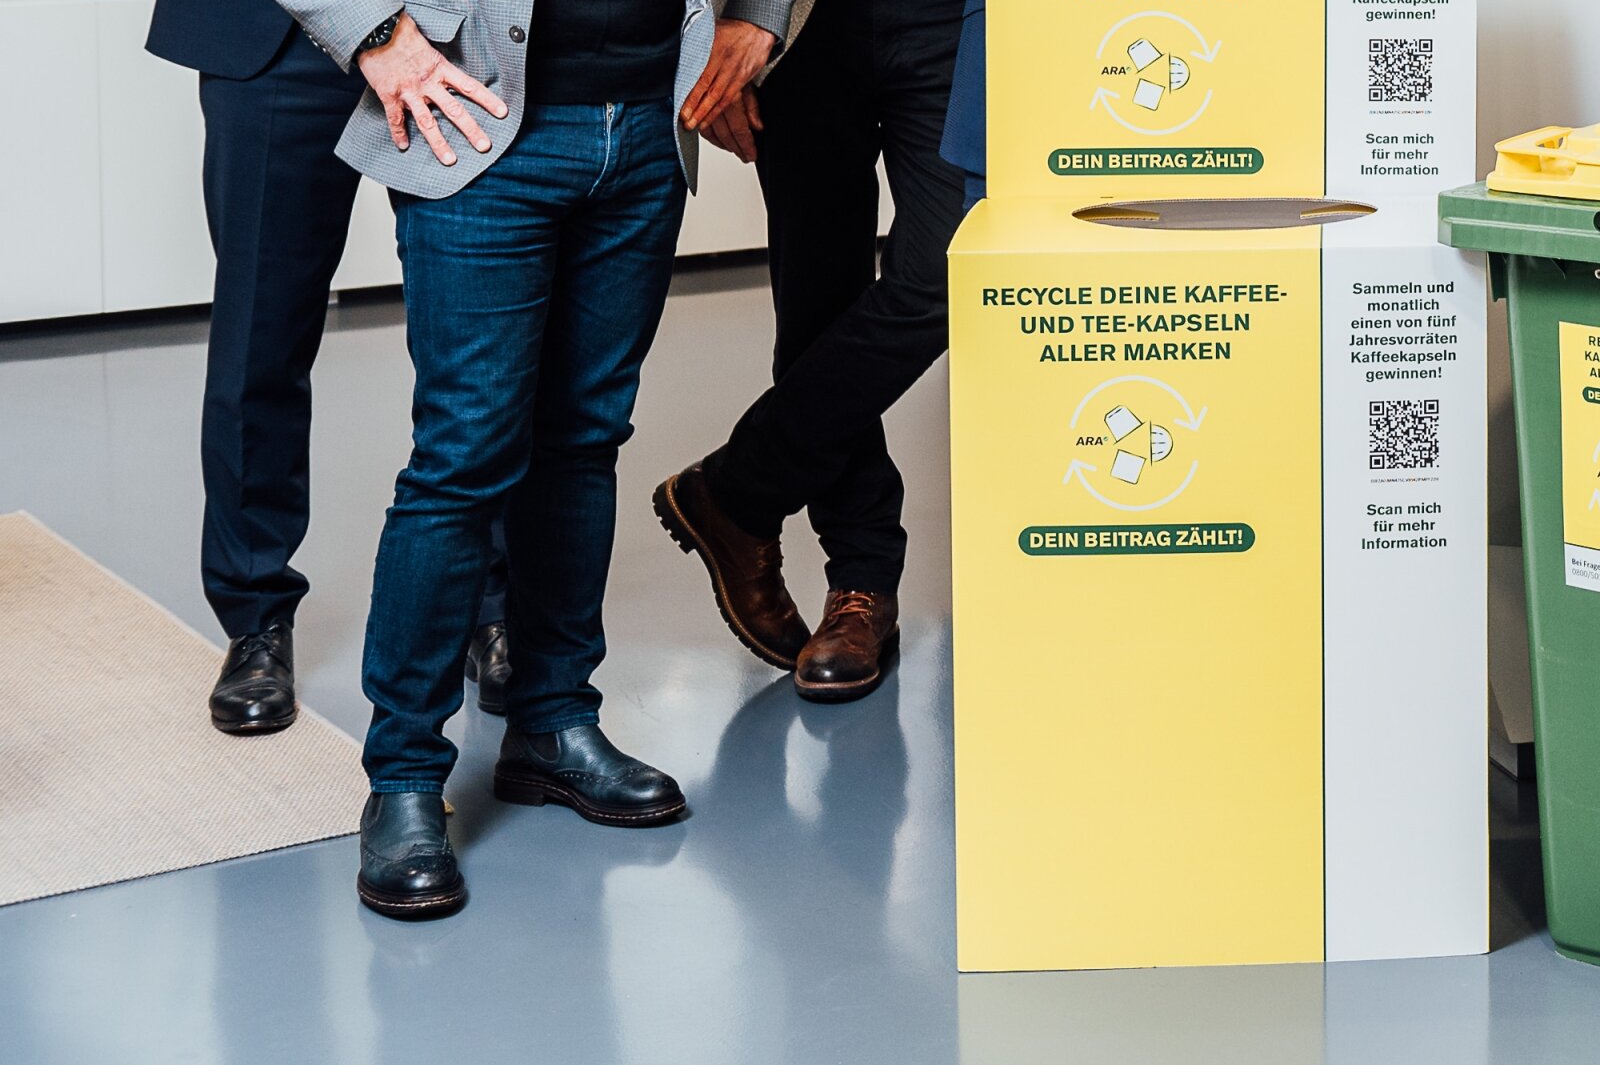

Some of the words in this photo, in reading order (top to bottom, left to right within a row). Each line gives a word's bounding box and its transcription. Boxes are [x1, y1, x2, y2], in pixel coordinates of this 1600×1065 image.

[1365, 8, 1436, 22] gewinnen!
[1100, 66, 1127, 75] ARA
[1365, 133, 1399, 144] Scan
[1403, 133, 1434, 144] mich
[1058, 154, 1103, 169] DEIN
[1108, 153, 1188, 169] BEITRAG
[1191, 150, 1253, 168] ZÄHLT!
[1371, 148, 1391, 160] für
[1394, 148, 1429, 160] mehr
[1360, 164, 1439, 176] Information
[982, 287, 1093, 306] RECYCLE
[1100, 285, 1177, 305] DEINE
[1184, 284, 1288, 304] KAFFEE-
[1352, 281, 1422, 295] Sammeln
[1427, 281, 1454, 294] und
[1367, 298, 1440, 312] monatlich
[1020, 316, 1075, 335] UND
[1080, 313, 1250, 334] TEE-KAPSELN
[1350, 317, 1392, 329] einen
[1396, 318, 1422, 328] von
[1427, 315, 1457, 328] fünf
[1349, 332, 1458, 347] Jahresvorräten
[1039, 343, 1116, 363] ALLER
[1124, 342, 1231, 361] MARKEN
[1351, 349, 1457, 365] Kaffeekapseln
[1365, 366, 1442, 383] gewinnen!
[1075, 436, 1104, 446] ARA
[1366, 503, 1403, 516] Scan
[1407, 502, 1442, 515] mich
[1373, 520, 1394, 533] für
[1398, 519, 1436, 532] mehr
[1029, 532, 1079, 549] DEIN
[1084, 530, 1171, 548] BEITRAG
[1175, 526, 1243, 546] ZÄHLT!
[1361, 535, 1447, 550] Information
[1572, 558, 1582, 566] Bei
